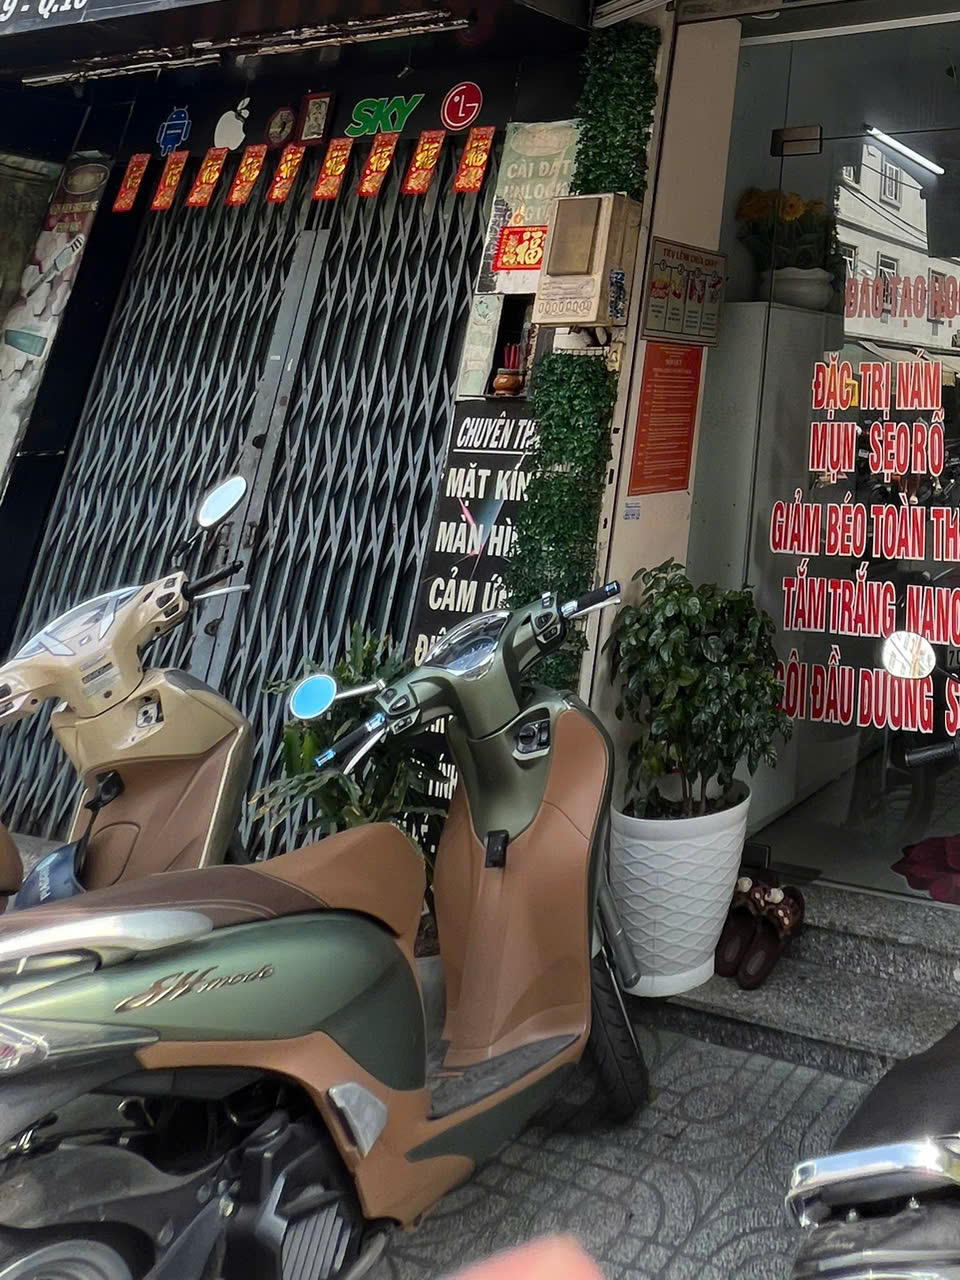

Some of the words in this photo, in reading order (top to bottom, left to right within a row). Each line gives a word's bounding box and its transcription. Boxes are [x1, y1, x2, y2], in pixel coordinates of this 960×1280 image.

[344, 93, 426, 137] SKY
[812, 353, 853, 420] ĐẶC
[858, 360, 892, 421] TRỊ
[896, 349, 943, 410] NÁM
[456, 411, 513, 450] CHUYÊN
[809, 421, 856, 483] MỤN
[446, 462, 492, 508] MẶT
[434, 515, 482, 556] MÀN
[770, 487, 821, 556] GIẢM
[825, 490, 867, 558] BÉO
[871, 492, 926, 560] TOÀN
[429, 566, 478, 613] CẢM
[783, 558, 827, 632] TẮM
[828, 561, 896, 640] TRẮNG
[810, 644, 854, 726] ĐẦU
